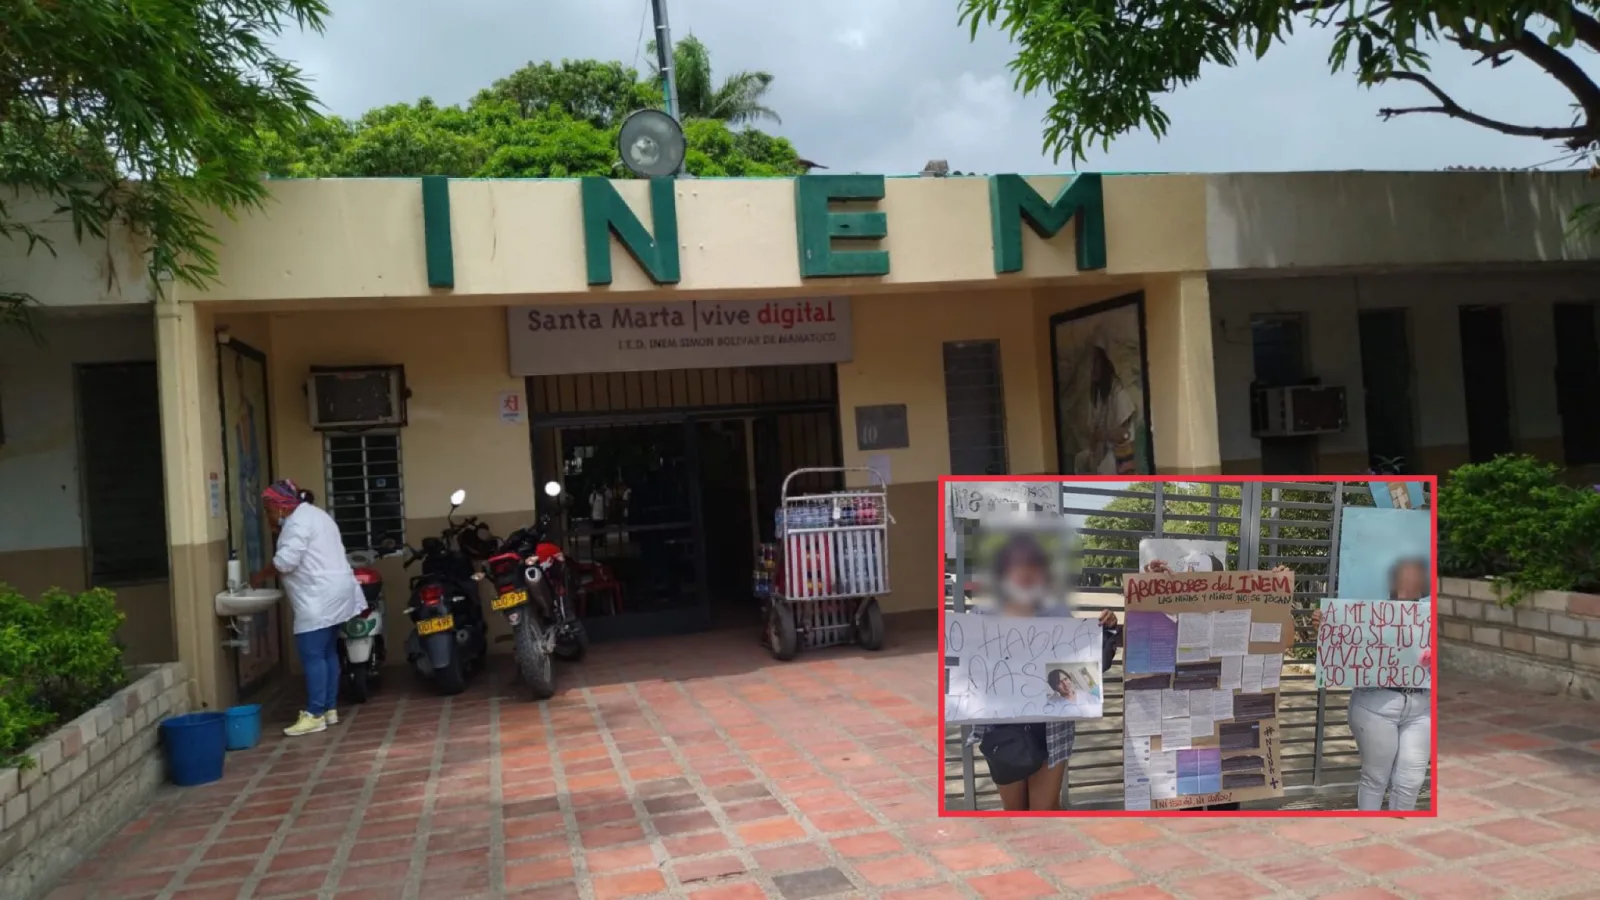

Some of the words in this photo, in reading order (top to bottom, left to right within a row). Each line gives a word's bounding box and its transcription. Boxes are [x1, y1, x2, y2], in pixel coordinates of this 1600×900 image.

[422, 173, 1106, 287] INEM
[528, 308, 603, 331] Santa
[611, 306, 685, 329] Marta
[702, 304, 750, 325] vive
[757, 299, 836, 329] digital
[1126, 578, 1208, 604] ABUSADORES
[1212, 575, 1234, 591] del
[1236, 574, 1291, 593] INEM
[1158, 595, 1173, 604] LAS
[1202, 594, 1207, 603] Y
[1236, 594, 1249, 604] NO
[1264, 594, 1292, 605] TOCAN
[1323, 601, 1338, 623] A
[1370, 601, 1395, 625] NO
[1400, 602, 1425, 627] ME
[945, 620, 964, 652] O
[1319, 624, 1363, 646] PERO
[1349, 665, 1370, 686] TE
[1377, 665, 1426, 688] CREO
